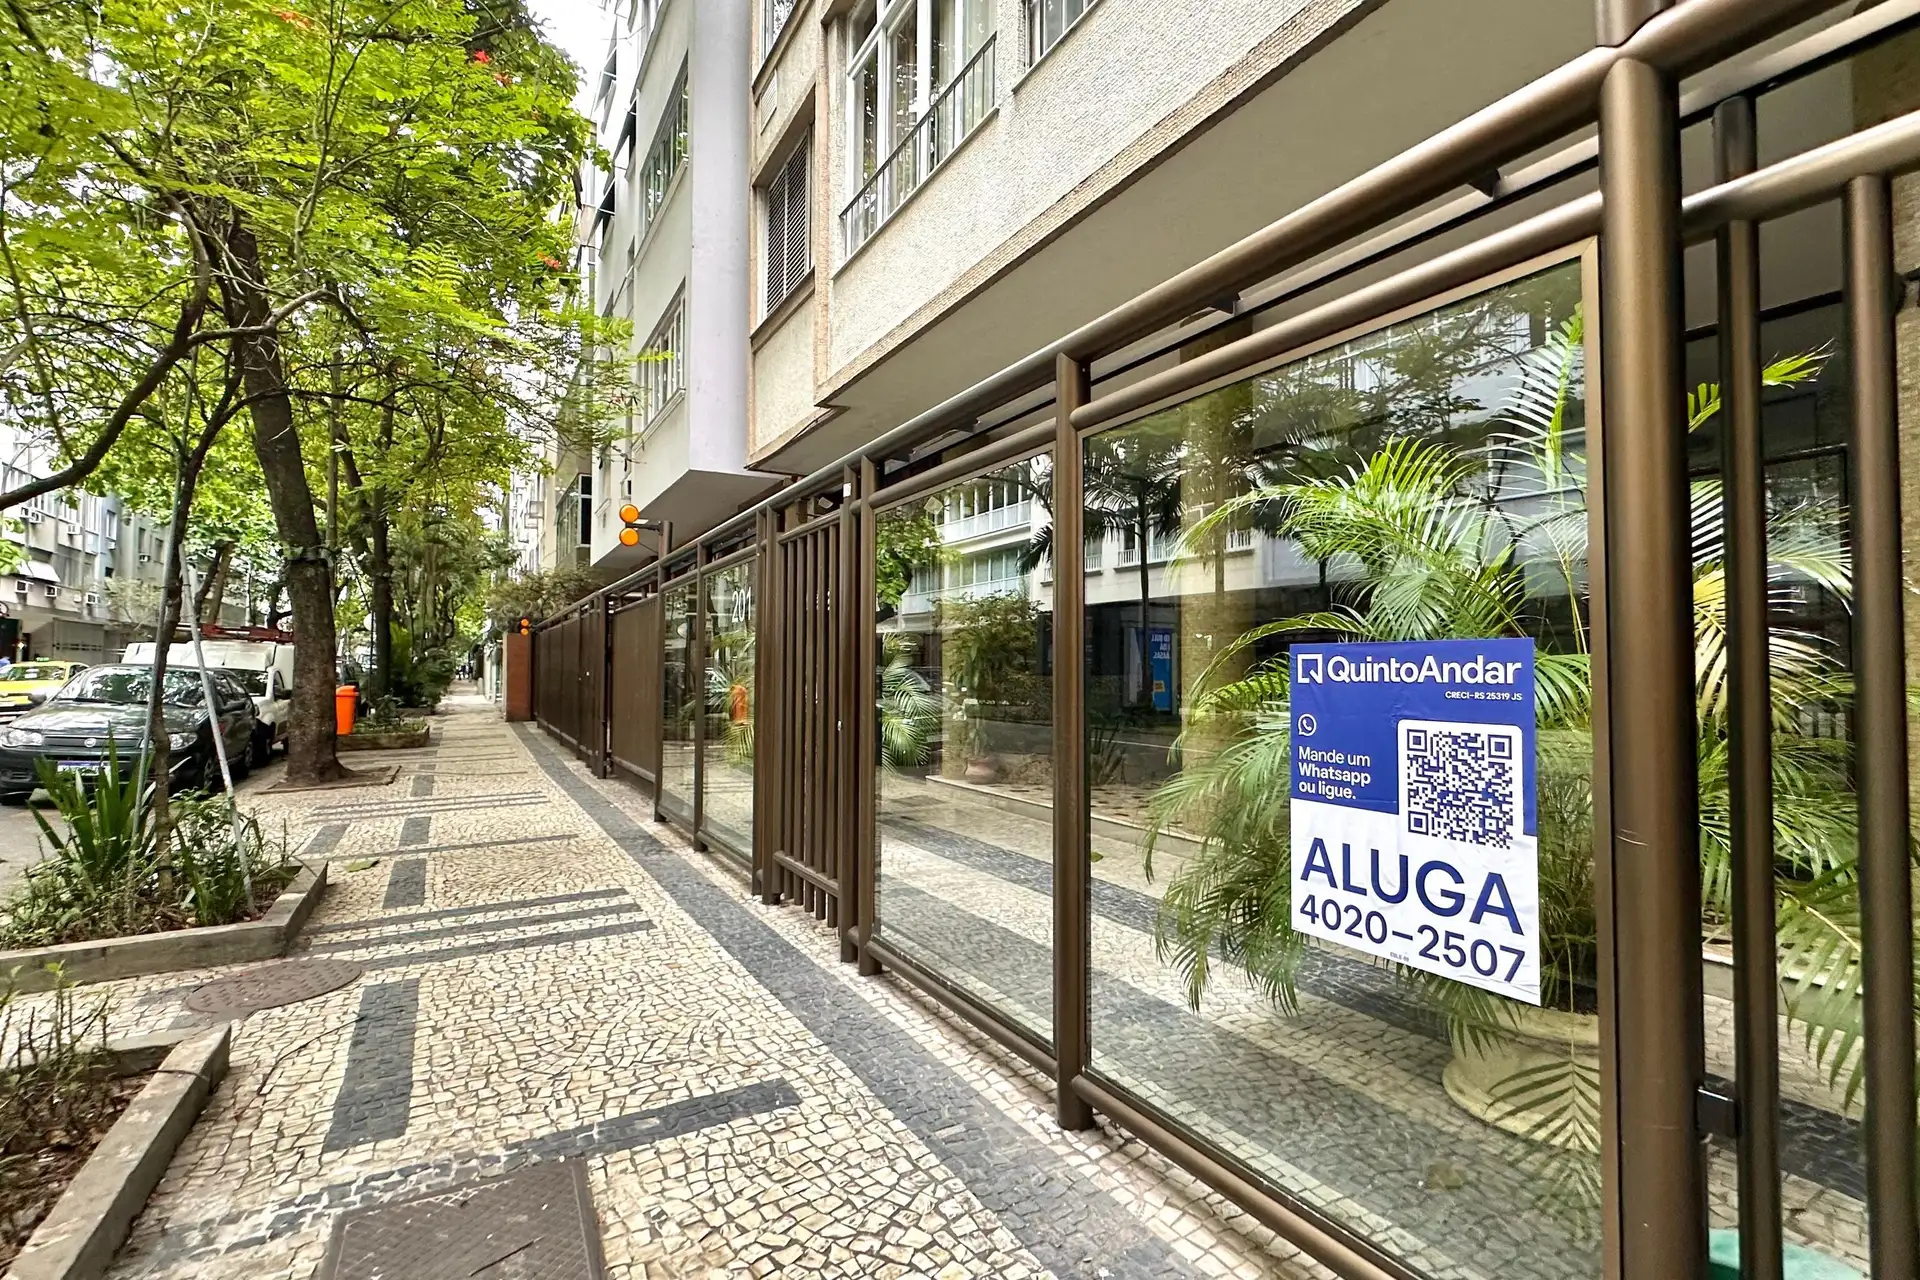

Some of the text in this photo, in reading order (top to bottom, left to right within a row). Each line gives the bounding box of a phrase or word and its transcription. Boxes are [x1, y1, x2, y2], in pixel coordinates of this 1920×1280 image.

[731, 586, 752, 623] 201
[1327, 655, 1522, 684] QuintoAndar
[1445, 690, 1523, 701] CRECI-RS 25319 JS
[1298, 745, 1371, 767] Mande um
[1298, 762, 1371, 787] Whatsapp
[1298, 780, 1357, 800] ou ligue.
[1300, 837, 1525, 936] ALUGA
[1300, 894, 1526, 983] 4020-2507
